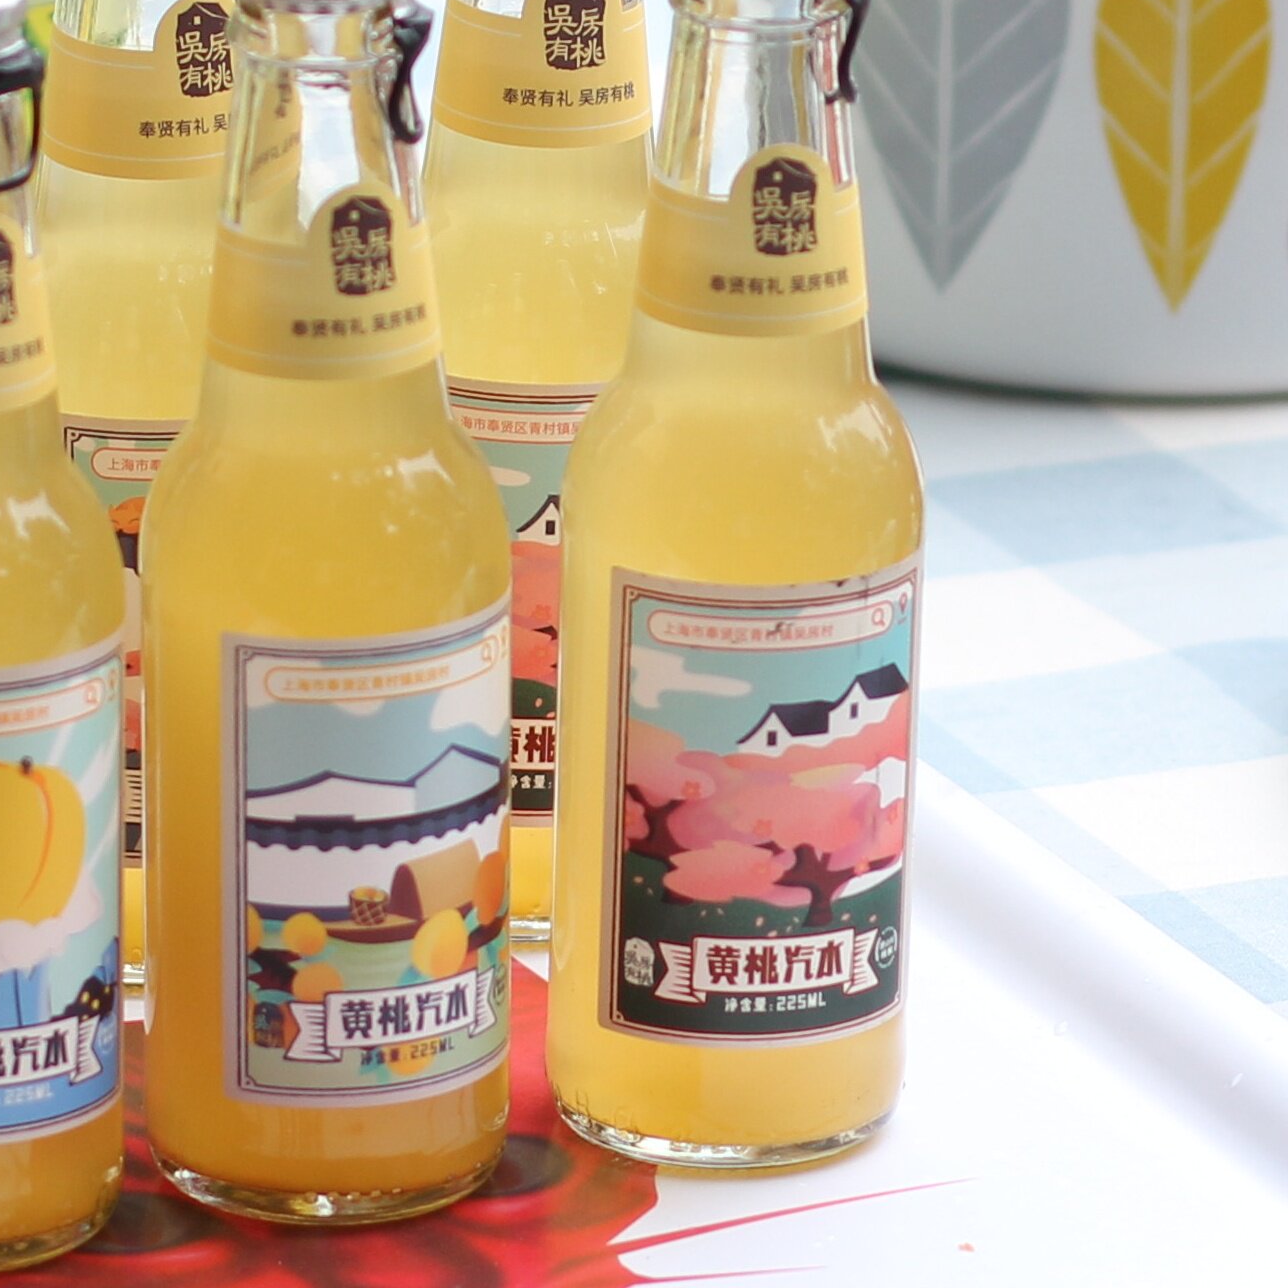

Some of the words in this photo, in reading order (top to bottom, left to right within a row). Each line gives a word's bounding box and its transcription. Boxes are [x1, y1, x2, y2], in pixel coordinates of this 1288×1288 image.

[503, 87, 573, 107] 奉贤有礼
[579, 81, 635, 105] 吴房有桃
[139, 118, 209, 138] 奉贤有礼
[213, 113, 230, 132] 吴
[707, 939, 844, 985] 黄桃汽水
[341, 983, 469, 1040] 黄桃汽水
[776, 992, 826, 1012] 225ML
[410, 1038, 455, 1060] 225ML
